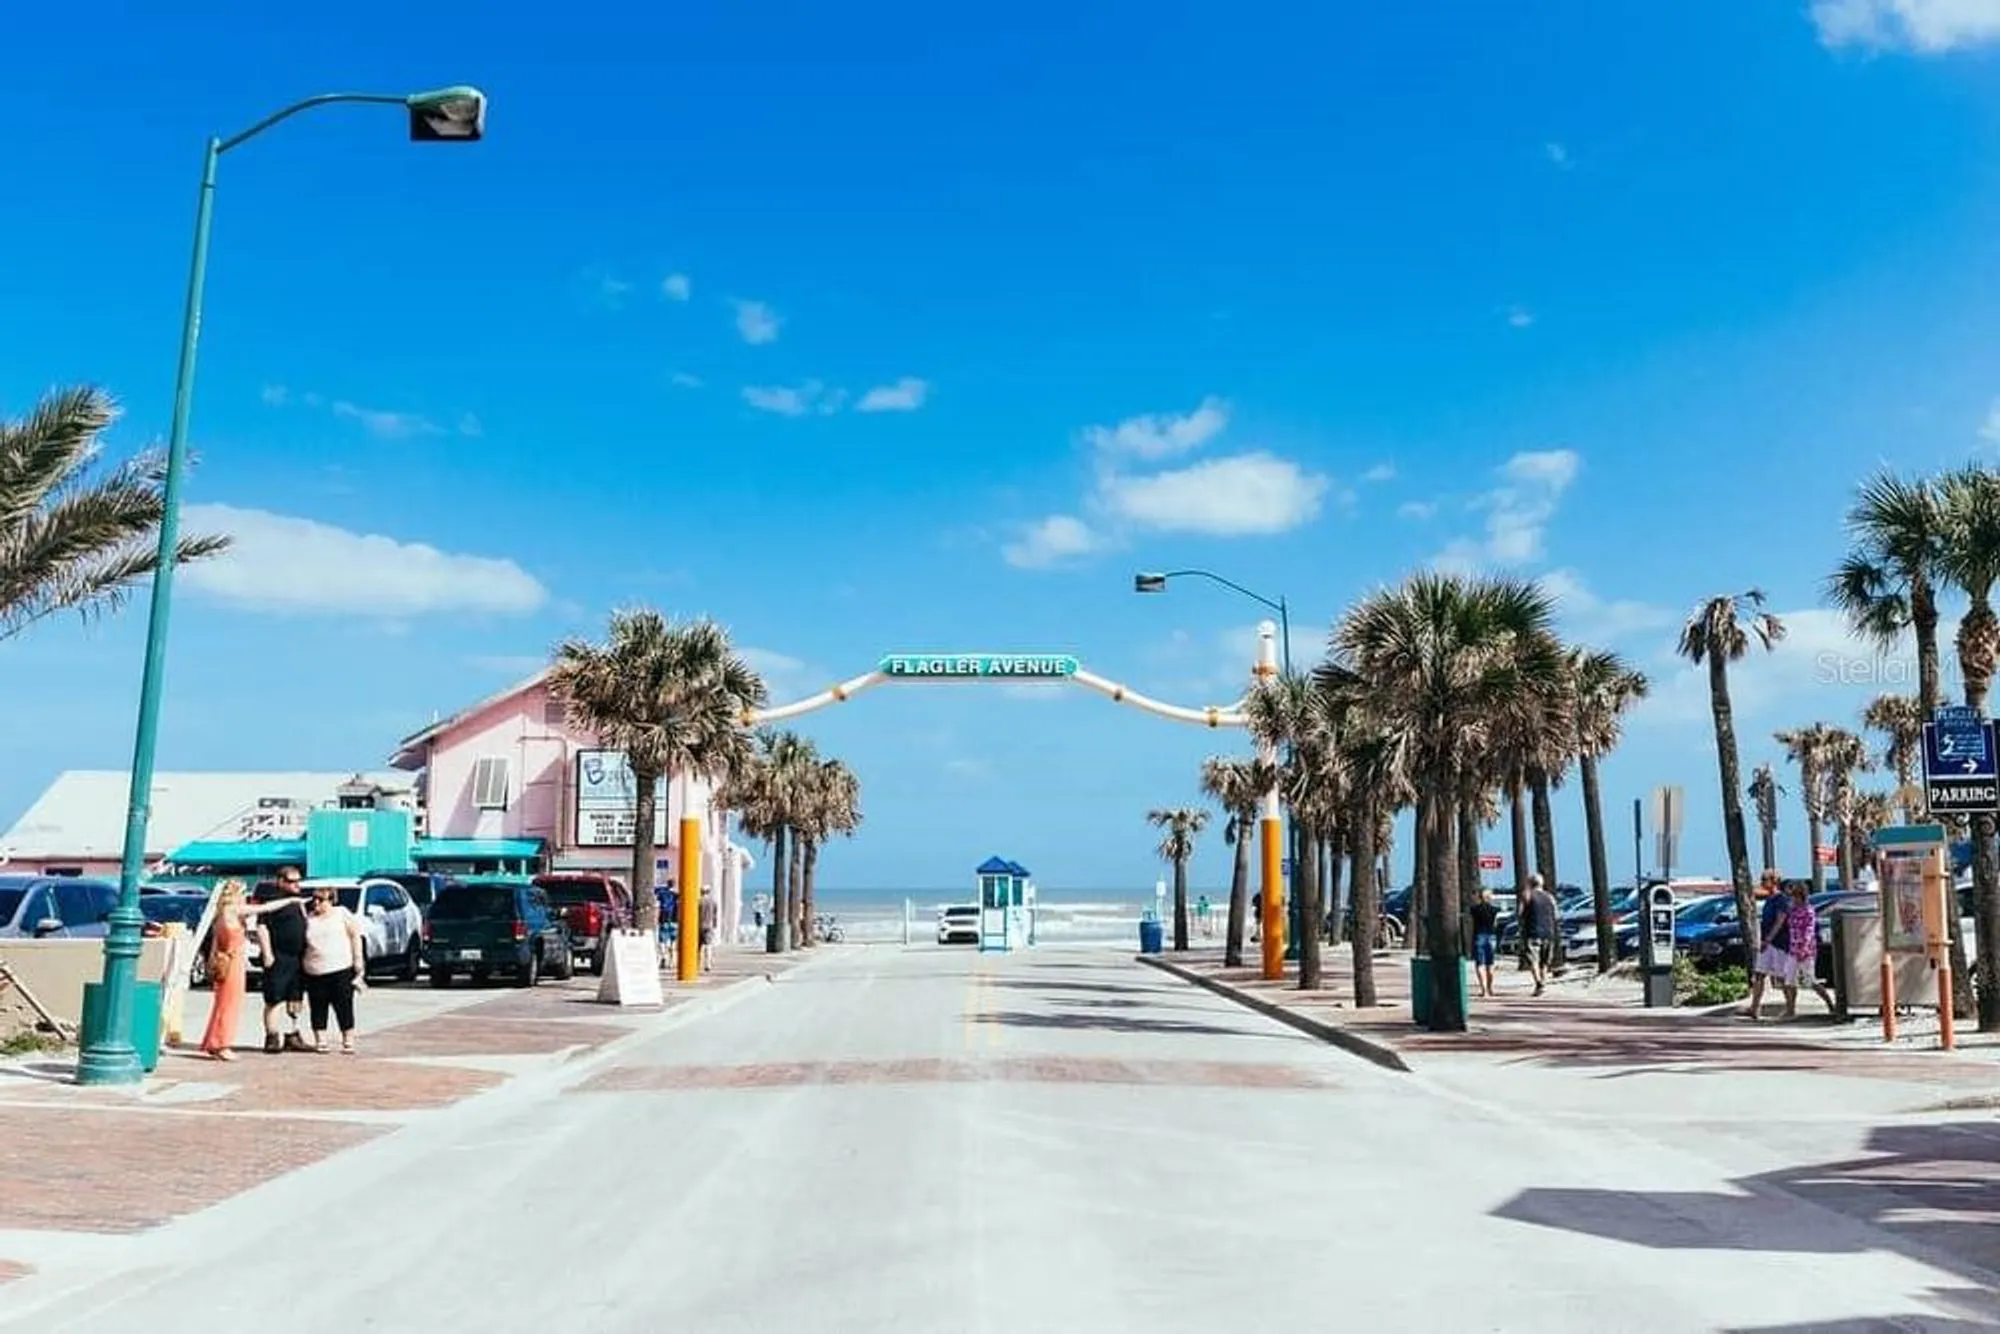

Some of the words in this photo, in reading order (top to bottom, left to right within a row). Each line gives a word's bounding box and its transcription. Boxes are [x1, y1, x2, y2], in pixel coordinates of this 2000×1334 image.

[891, 658, 981, 674] FLAGLER
[988, 658, 1066, 674] AVENUE
[1931, 787, 1996, 802] PARKING
